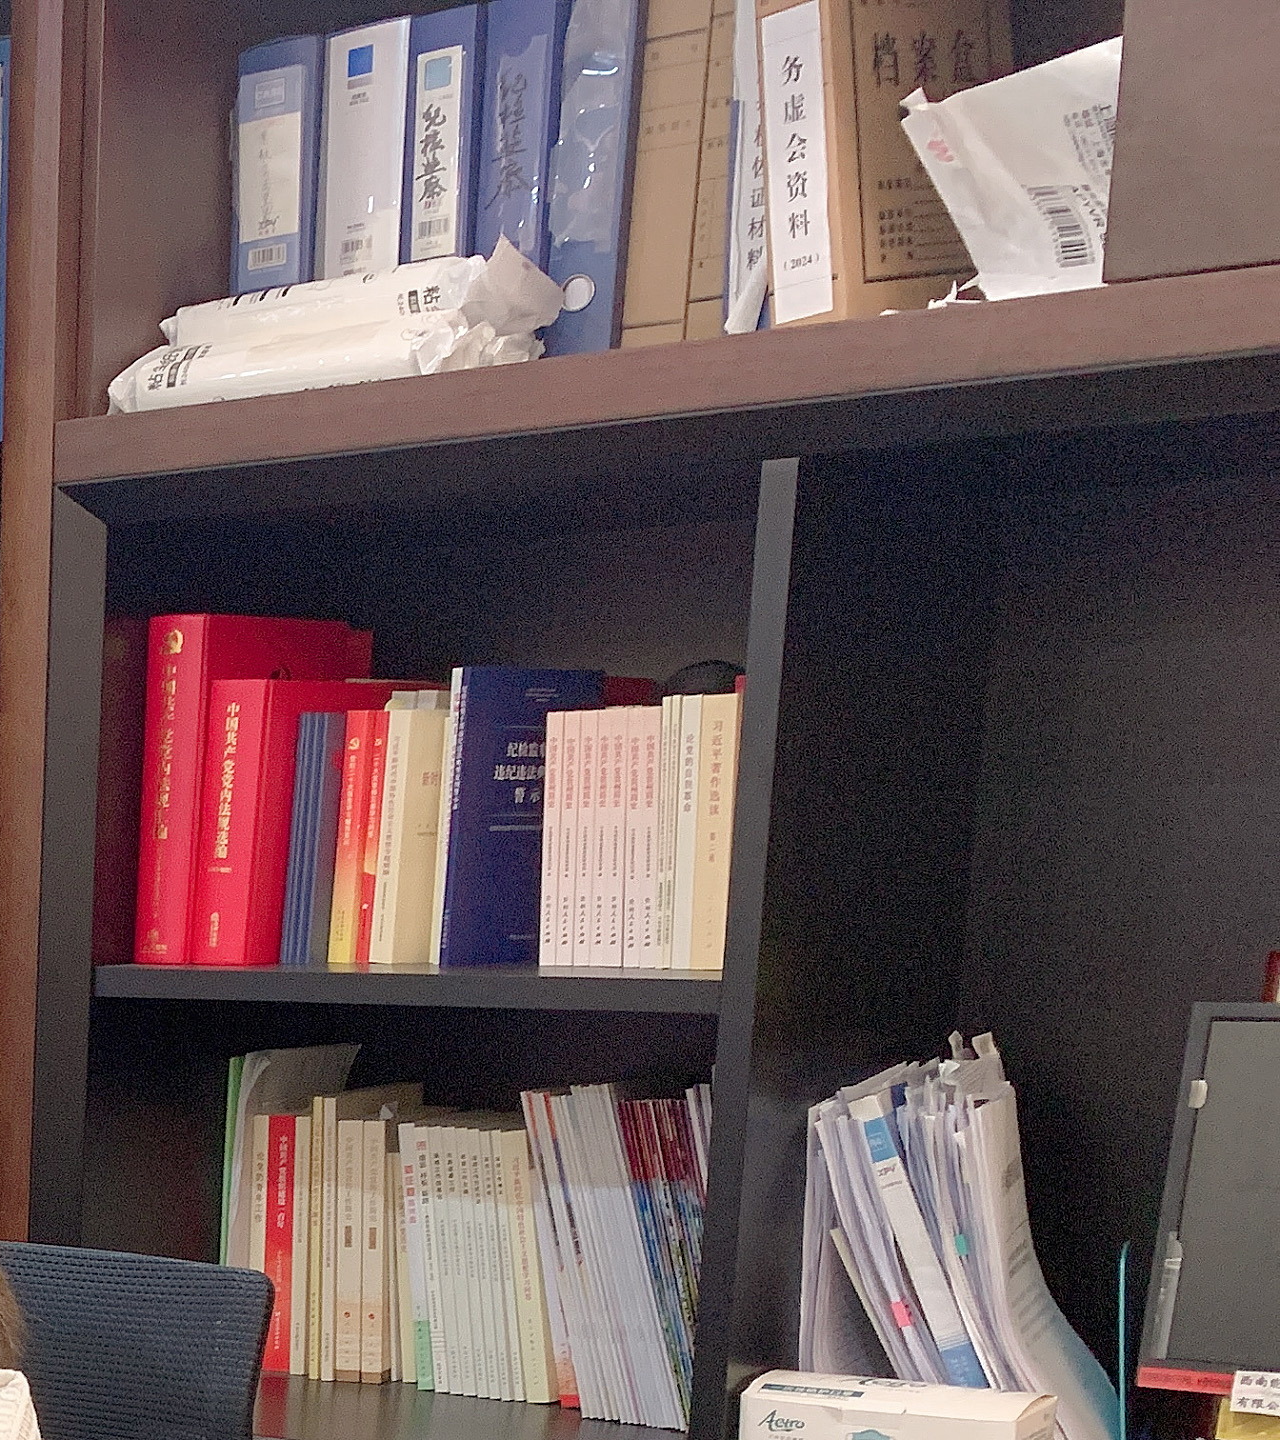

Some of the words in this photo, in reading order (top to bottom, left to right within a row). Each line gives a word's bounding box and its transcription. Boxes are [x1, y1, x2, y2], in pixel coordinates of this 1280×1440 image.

[782, 55, 811, 239] 务虚会资料
